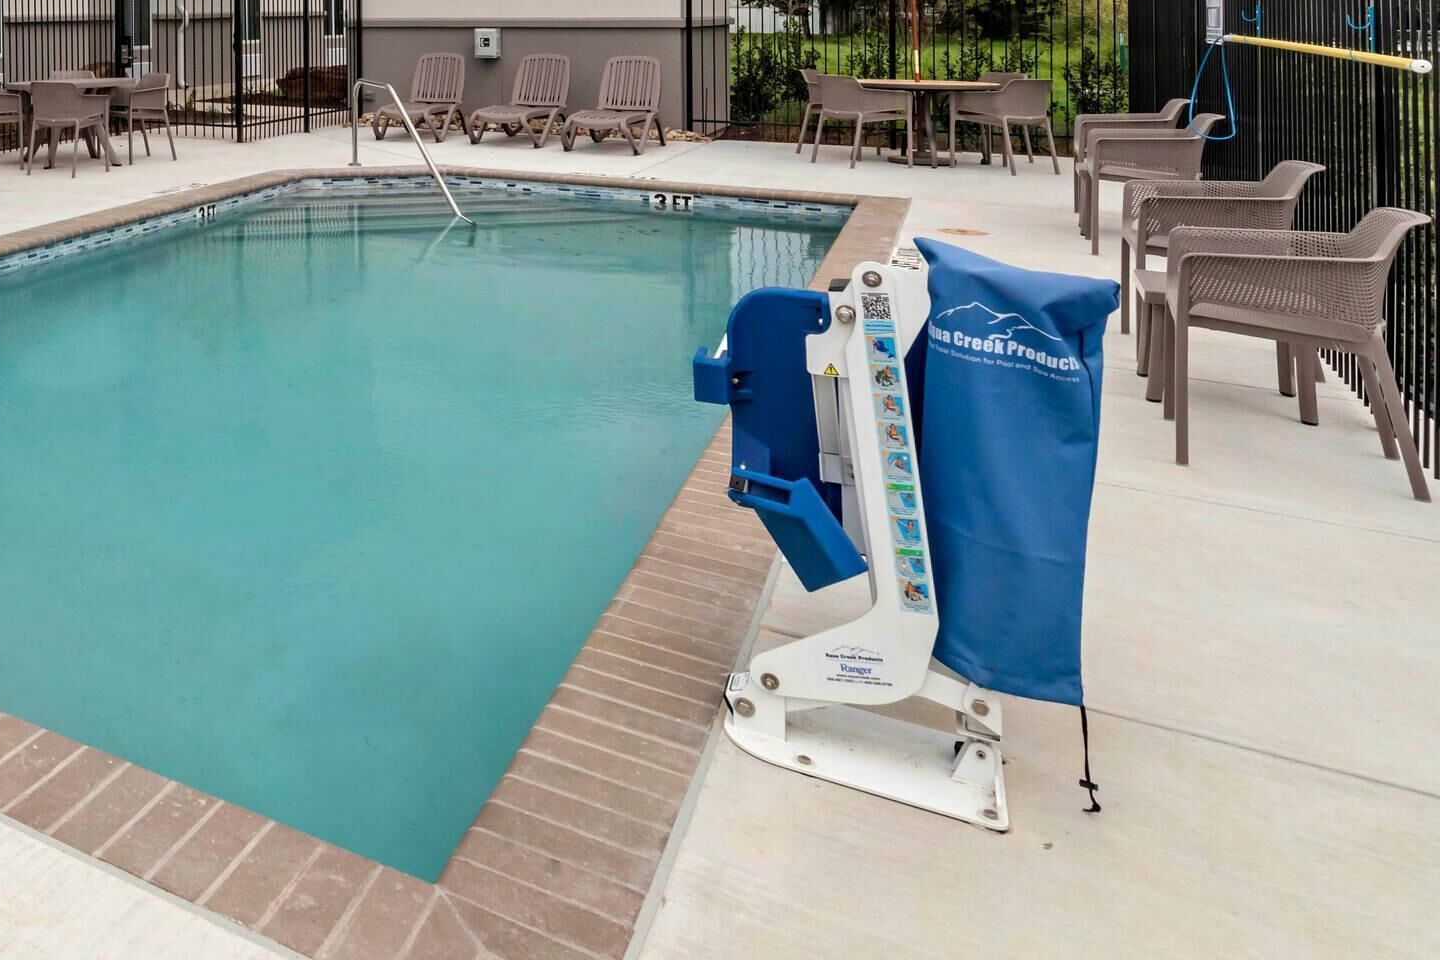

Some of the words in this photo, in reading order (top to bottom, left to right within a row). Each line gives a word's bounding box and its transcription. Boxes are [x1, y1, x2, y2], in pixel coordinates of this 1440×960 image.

[672, 194, 692, 206] FT
[207, 204, 216, 216] FT
[953, 330, 1005, 355] Creek
[950, 349, 982, 363] Solution
[983, 357, 995, 365] for
[996, 359, 1014, 368] Pool
[1015, 362, 1031, 371] and
[840, 663, 873, 676] Ranger
